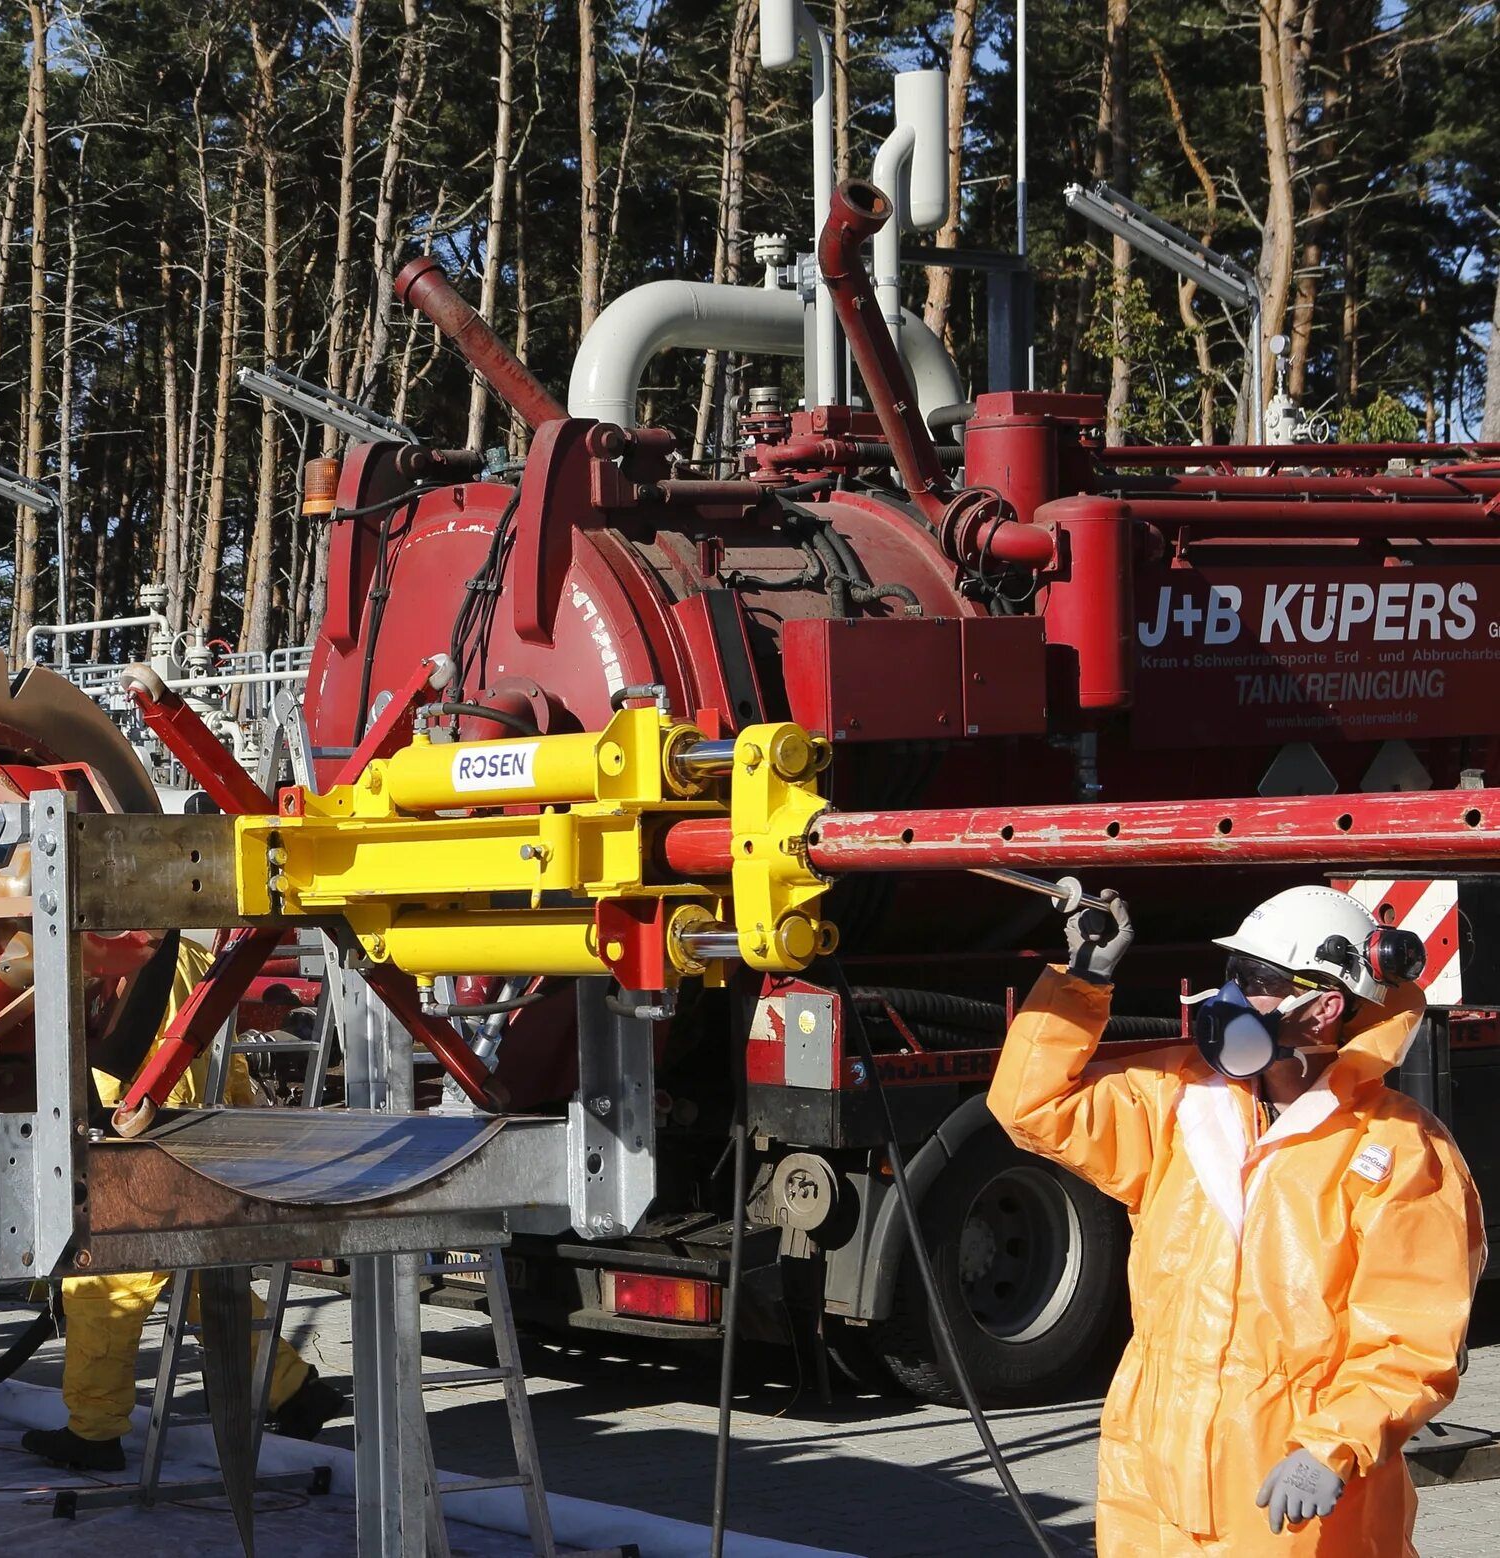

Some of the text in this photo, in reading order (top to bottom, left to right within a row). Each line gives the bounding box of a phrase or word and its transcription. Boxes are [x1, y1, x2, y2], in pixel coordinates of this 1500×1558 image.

[1138, 584, 1242, 647] J+B
[1259, 582, 1478, 643] KÜPERS
[1141, 655, 1178, 669] Kran
[1334, 650, 1360, 664] Erd
[1378, 649, 1405, 663] und
[1235, 668, 1446, 705] TANKREINIGUNG
[460, 752, 527, 780] ROSEN
